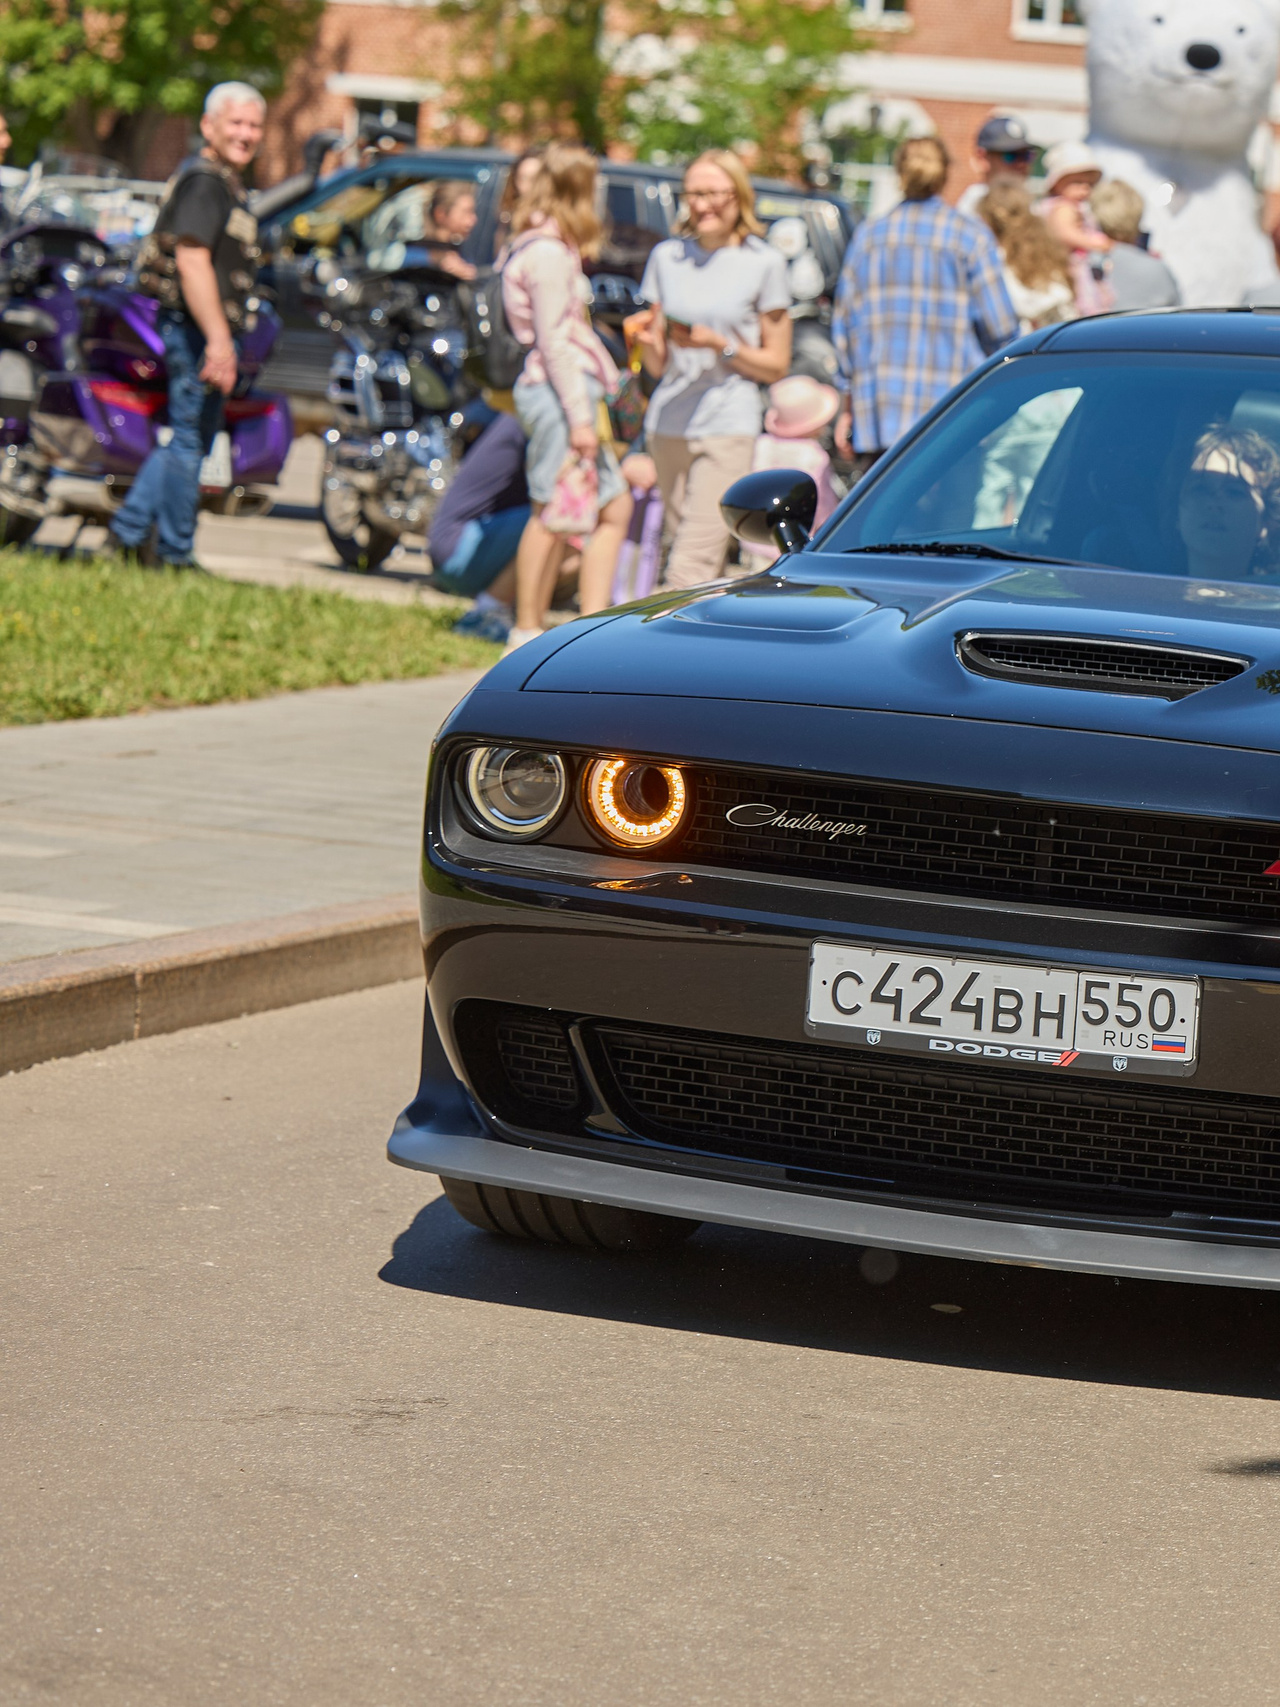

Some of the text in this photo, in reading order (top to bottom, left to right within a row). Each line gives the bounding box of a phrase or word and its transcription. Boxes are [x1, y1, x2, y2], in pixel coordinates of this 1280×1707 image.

[725, 803, 867, 840] Challenger
[1081, 979, 1176, 1033] 550
[928, 1039, 1063, 1063] DODGE
[1103, 1030, 1149, 1049] RUS
